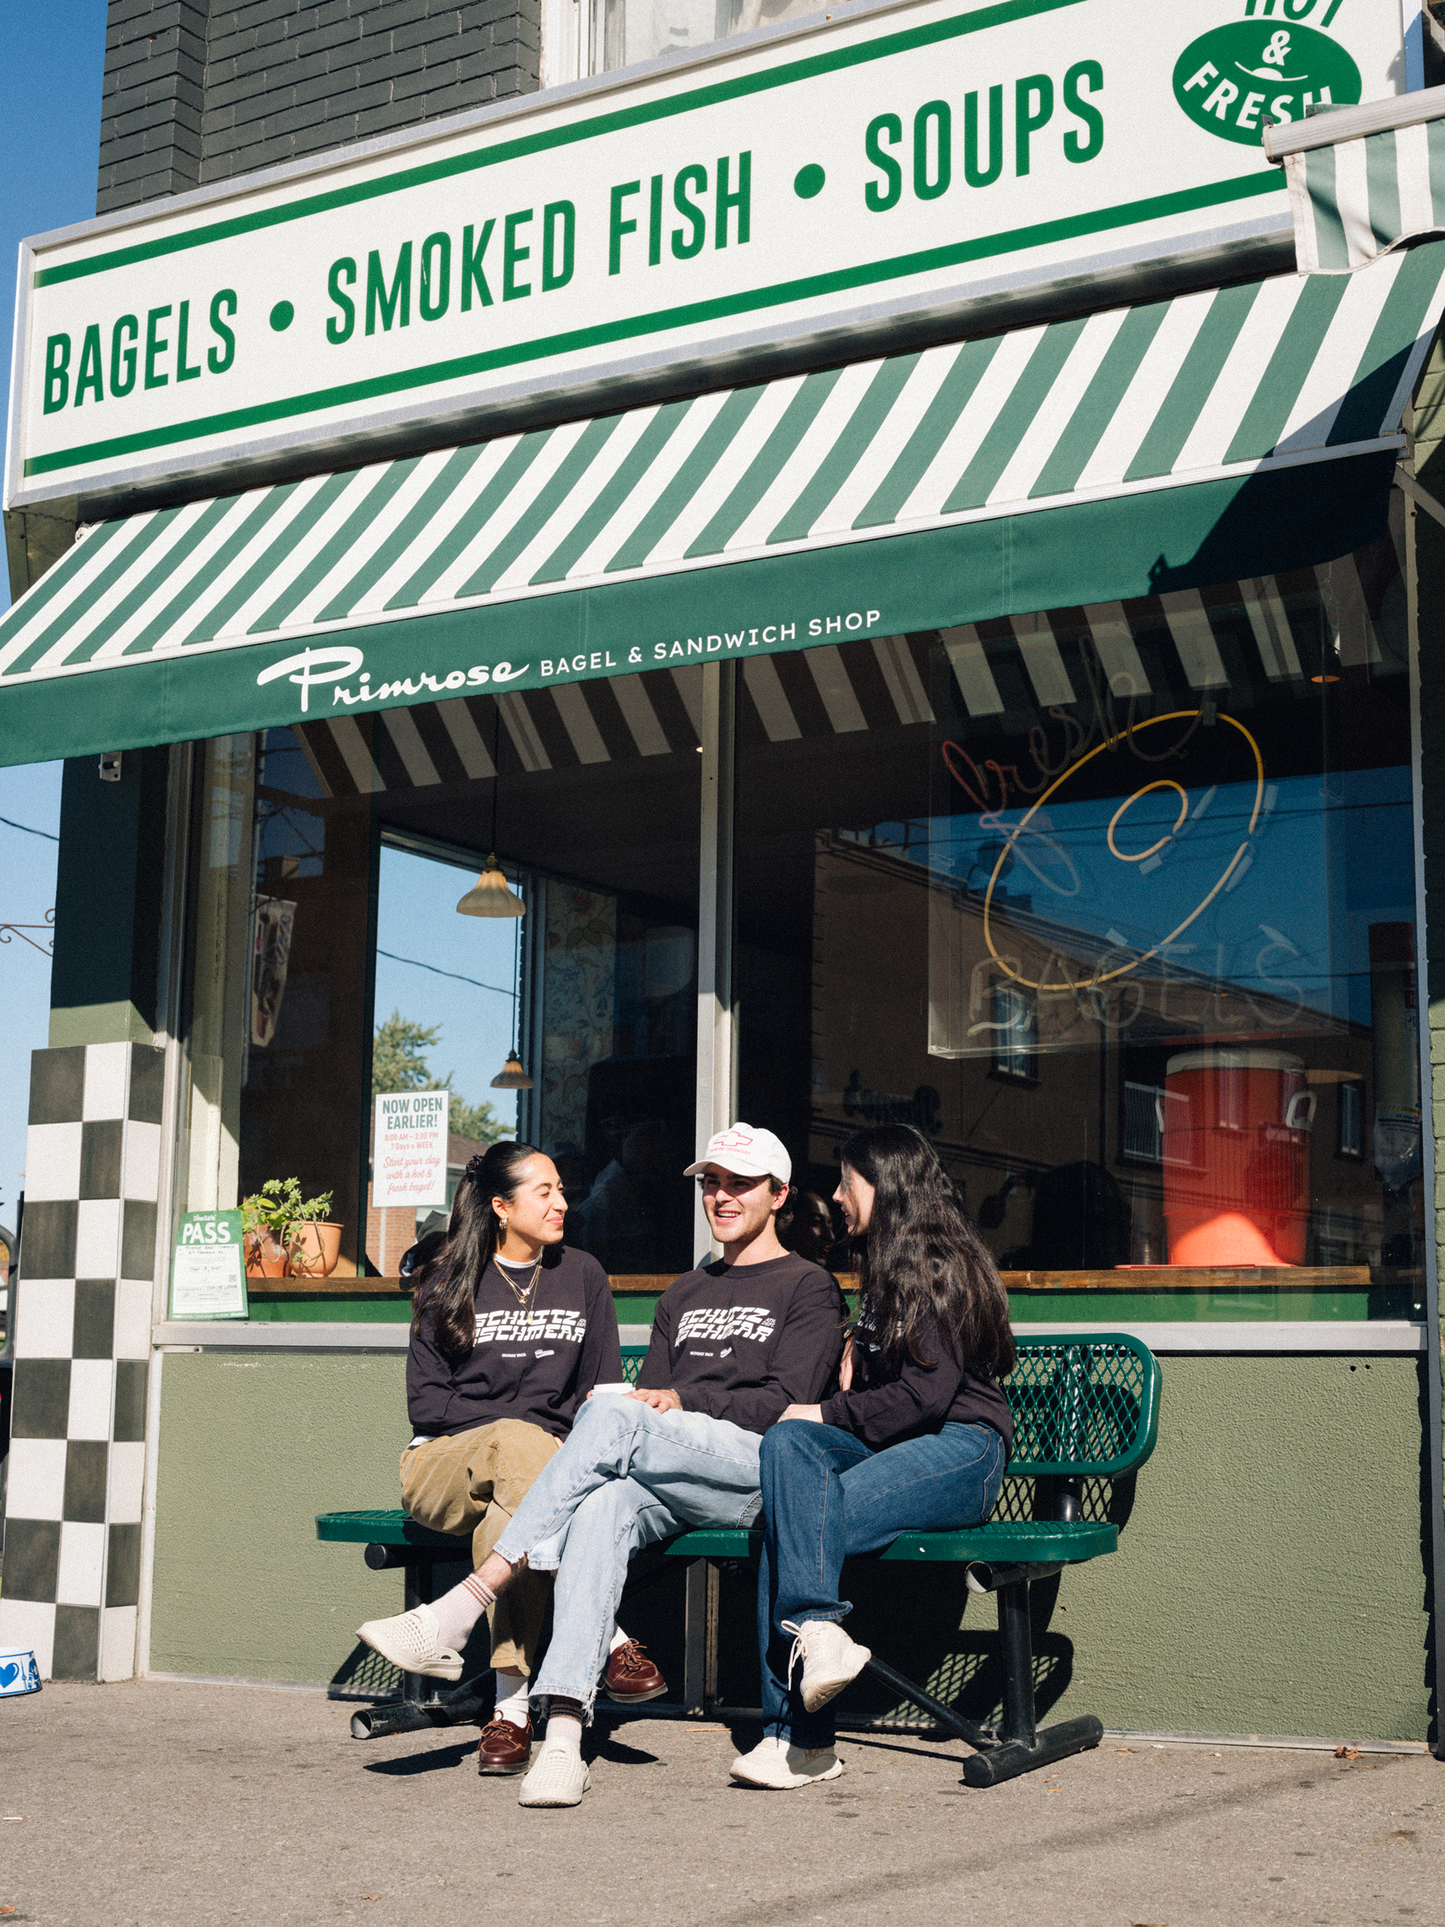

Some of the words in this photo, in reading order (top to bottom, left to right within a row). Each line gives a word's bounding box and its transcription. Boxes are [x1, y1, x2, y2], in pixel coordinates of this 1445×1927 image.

[1262, 30, 1292, 66] &
[43, 288, 238, 416] BAGELS
[326, 199, 576, 345] SMOKED
[608, 151, 752, 276] FISH
[865, 59, 1104, 213] SOUPS
[256, 645, 530, 713] Primrose
[540, 650, 617, 677] BAGEL
[628, 646, 643, 664] &
[653, 622, 796, 660] SANDWICH
[808, 609, 881, 637] SHOP
[967, 941, 1305, 1037] BAGELS
[383, 1099, 409, 1114] NOW
[413, 1097, 442, 1112] OPEN
[387, 1114, 438, 1129] EARLIER!
[416, 1141, 433, 1149] WEEK
[383, 1156, 404, 1168] Start
[424, 1154, 441, 1168] day
[386, 1169, 403, 1180] with
[411, 1168, 425, 1179] hot
[387, 1182, 408, 1195] fresh
[408, 1180, 436, 1194] bagel!
[182, 1222, 231, 1244] PASS
